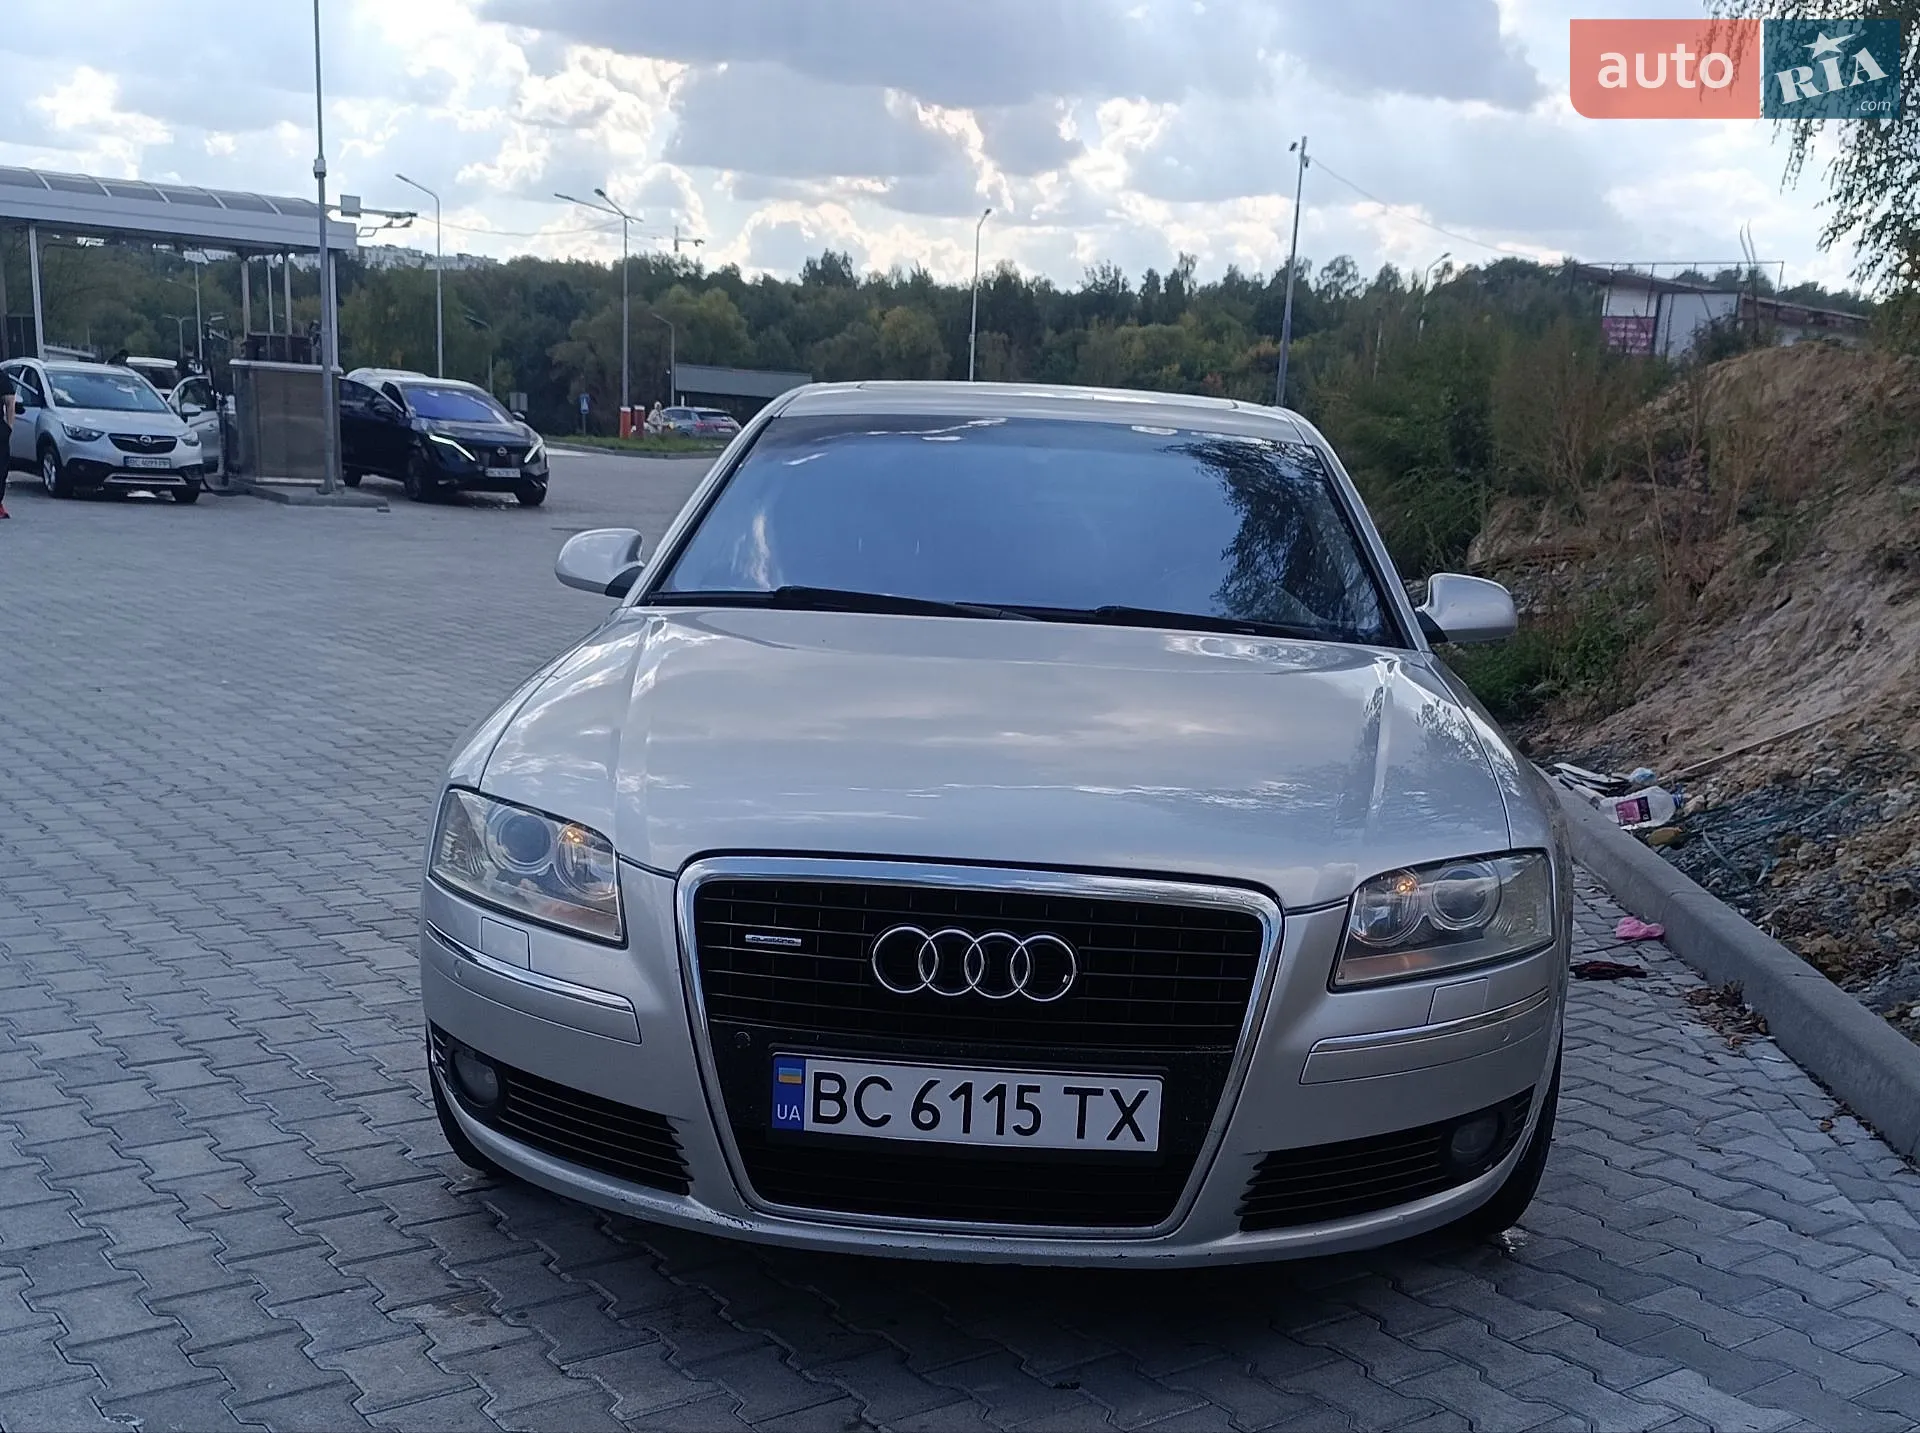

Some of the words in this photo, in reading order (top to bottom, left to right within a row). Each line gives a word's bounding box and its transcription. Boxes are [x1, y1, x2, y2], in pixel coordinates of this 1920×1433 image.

[776, 1103, 801, 1123] UA
[811, 1071, 893, 1128] BC
[910, 1079, 1043, 1137] 6115
[1063, 1086, 1150, 1143] TX
